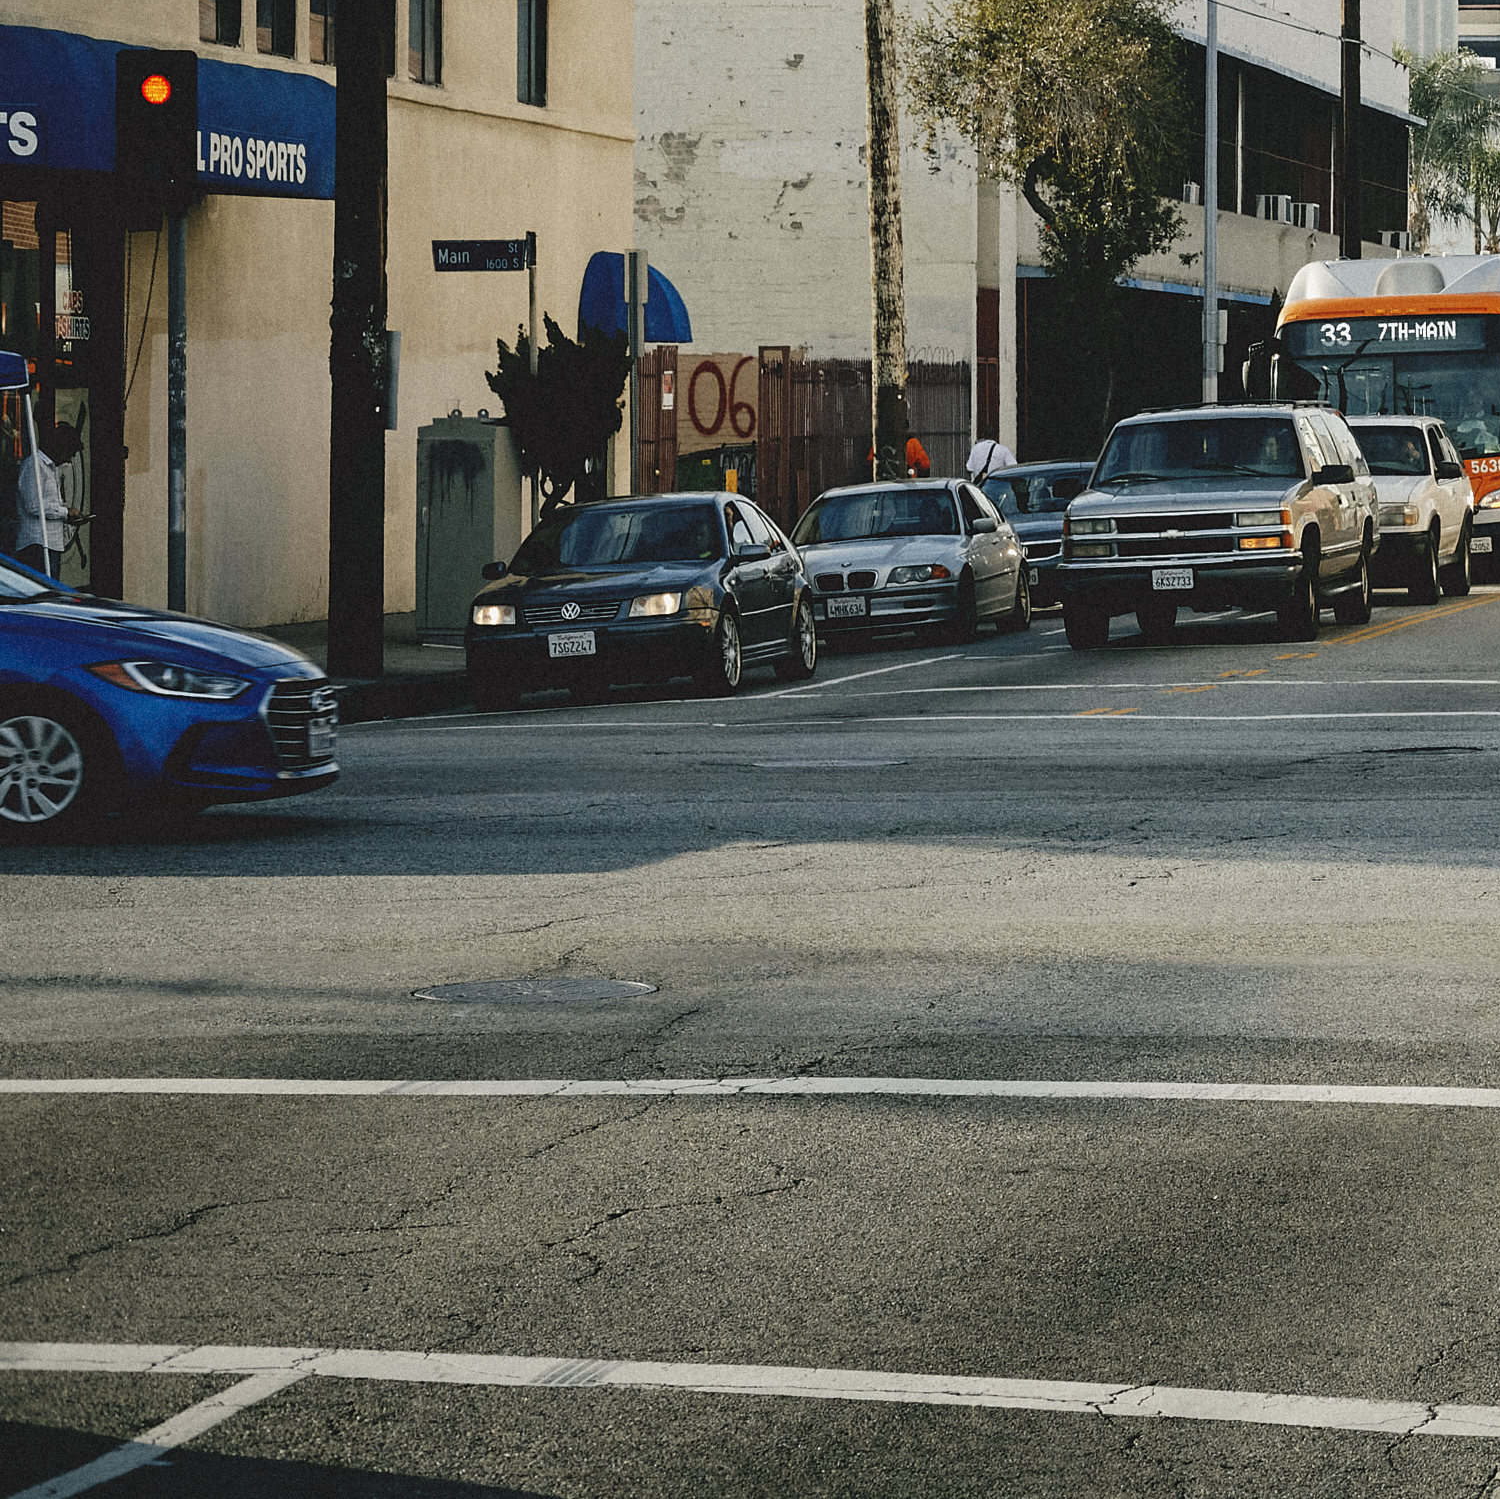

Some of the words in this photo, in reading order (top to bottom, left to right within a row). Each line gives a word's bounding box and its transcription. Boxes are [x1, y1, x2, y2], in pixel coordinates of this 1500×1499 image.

[209, 131, 244, 179] PRO
[245, 136, 307, 185] SPORTS
[437, 247, 470, 264] Main
[507, 241, 519, 254] St
[485, 258, 509, 269] 1600
[512, 257, 520, 269] S
[1320, 322, 1353, 348] 33
[1377, 320, 1458, 343] 7TH-MAIN
[687, 355, 757, 439] 06
